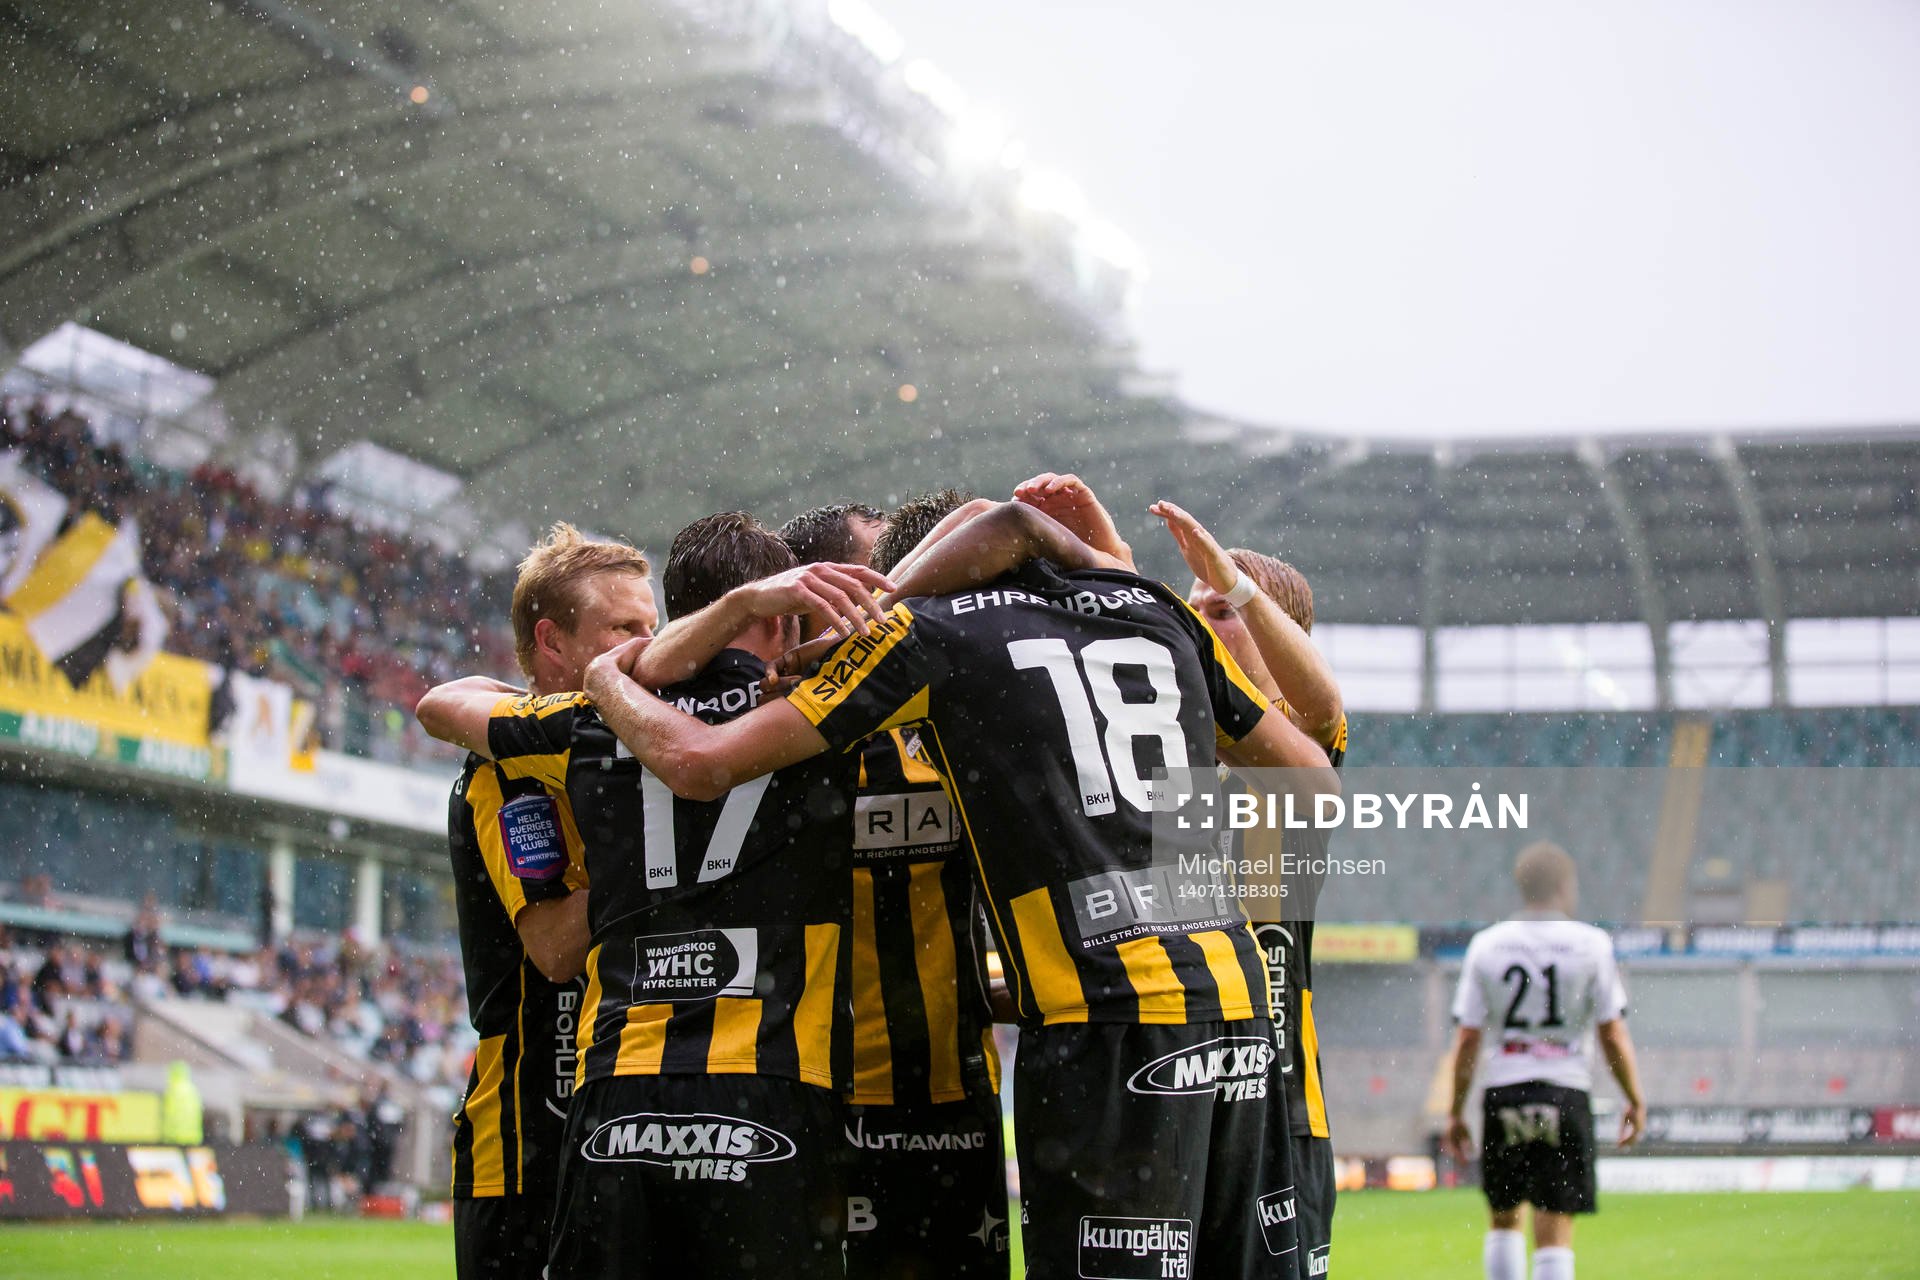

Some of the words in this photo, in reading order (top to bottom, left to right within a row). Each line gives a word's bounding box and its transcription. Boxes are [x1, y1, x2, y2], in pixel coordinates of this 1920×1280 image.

[1006, 636, 1194, 818] 18
[1086, 792, 1110, 806] BKH
[1146, 790, 1165, 802] BKH
[517, 812, 541, 825] HELA
[616, 738, 775, 890] 17
[509, 820, 553, 836] SVERIGES
[510, 829, 556, 845] FOTBOLLS
[520, 839, 550, 852] KLUBB
[866, 849, 905, 860] RIEMER
[649, 866, 673, 879] BKH
[707, 858, 731, 871] BKH
[1082, 925, 1150, 949] BILLSTRÖM
[1151, 924, 1180, 934] RIEMER
[1182, 918, 1234, 932] ANDERSSON
[646, 942, 717, 958] WANGESKOG
[648, 953, 715, 978] WHC
[642, 978, 718, 990] HYRCENTER
[1503, 963, 1564, 1029] 21
[555, 991, 578, 1099] BOHUS
[1173, 1042, 1269, 1090] MAXXIS
[1214, 1077, 1268, 1103] TYRES
[607, 1123, 756, 1157] MAXXIS
[672, 1159, 749, 1182] TYRES
[1083, 1220, 1190, 1257] kungälvs
[1160, 1251, 1188, 1279] trä
